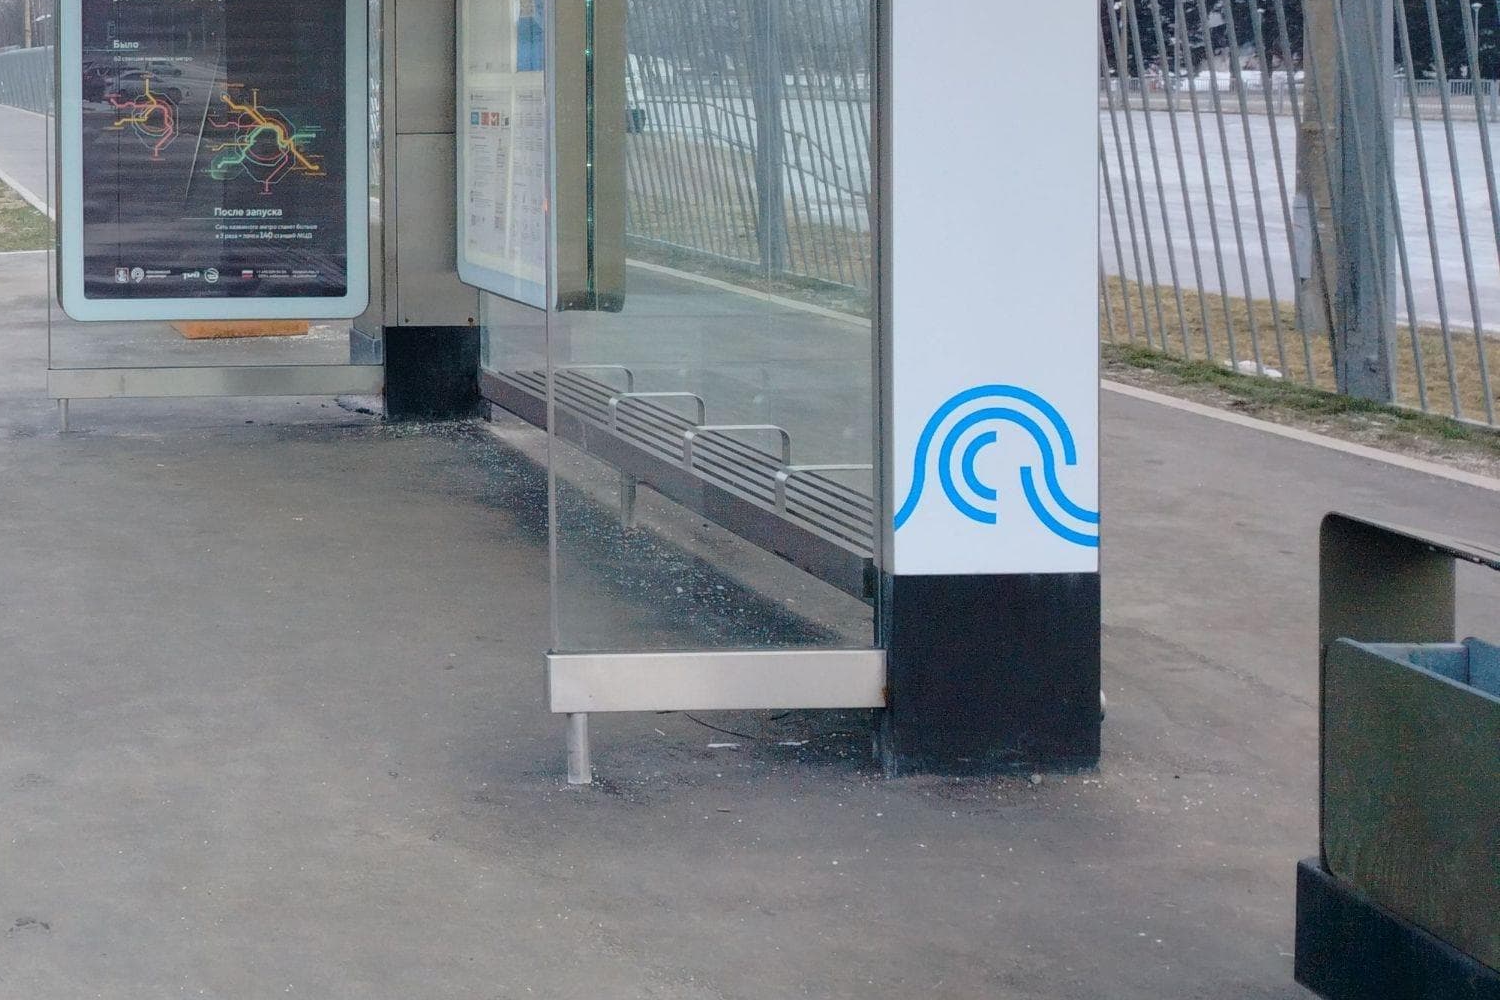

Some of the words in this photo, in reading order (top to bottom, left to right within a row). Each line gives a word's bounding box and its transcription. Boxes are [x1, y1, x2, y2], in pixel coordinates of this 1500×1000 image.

[113, 39, 140, 49] Было
[214, 207, 244, 217] После
[245, 208, 283, 218] запуска
